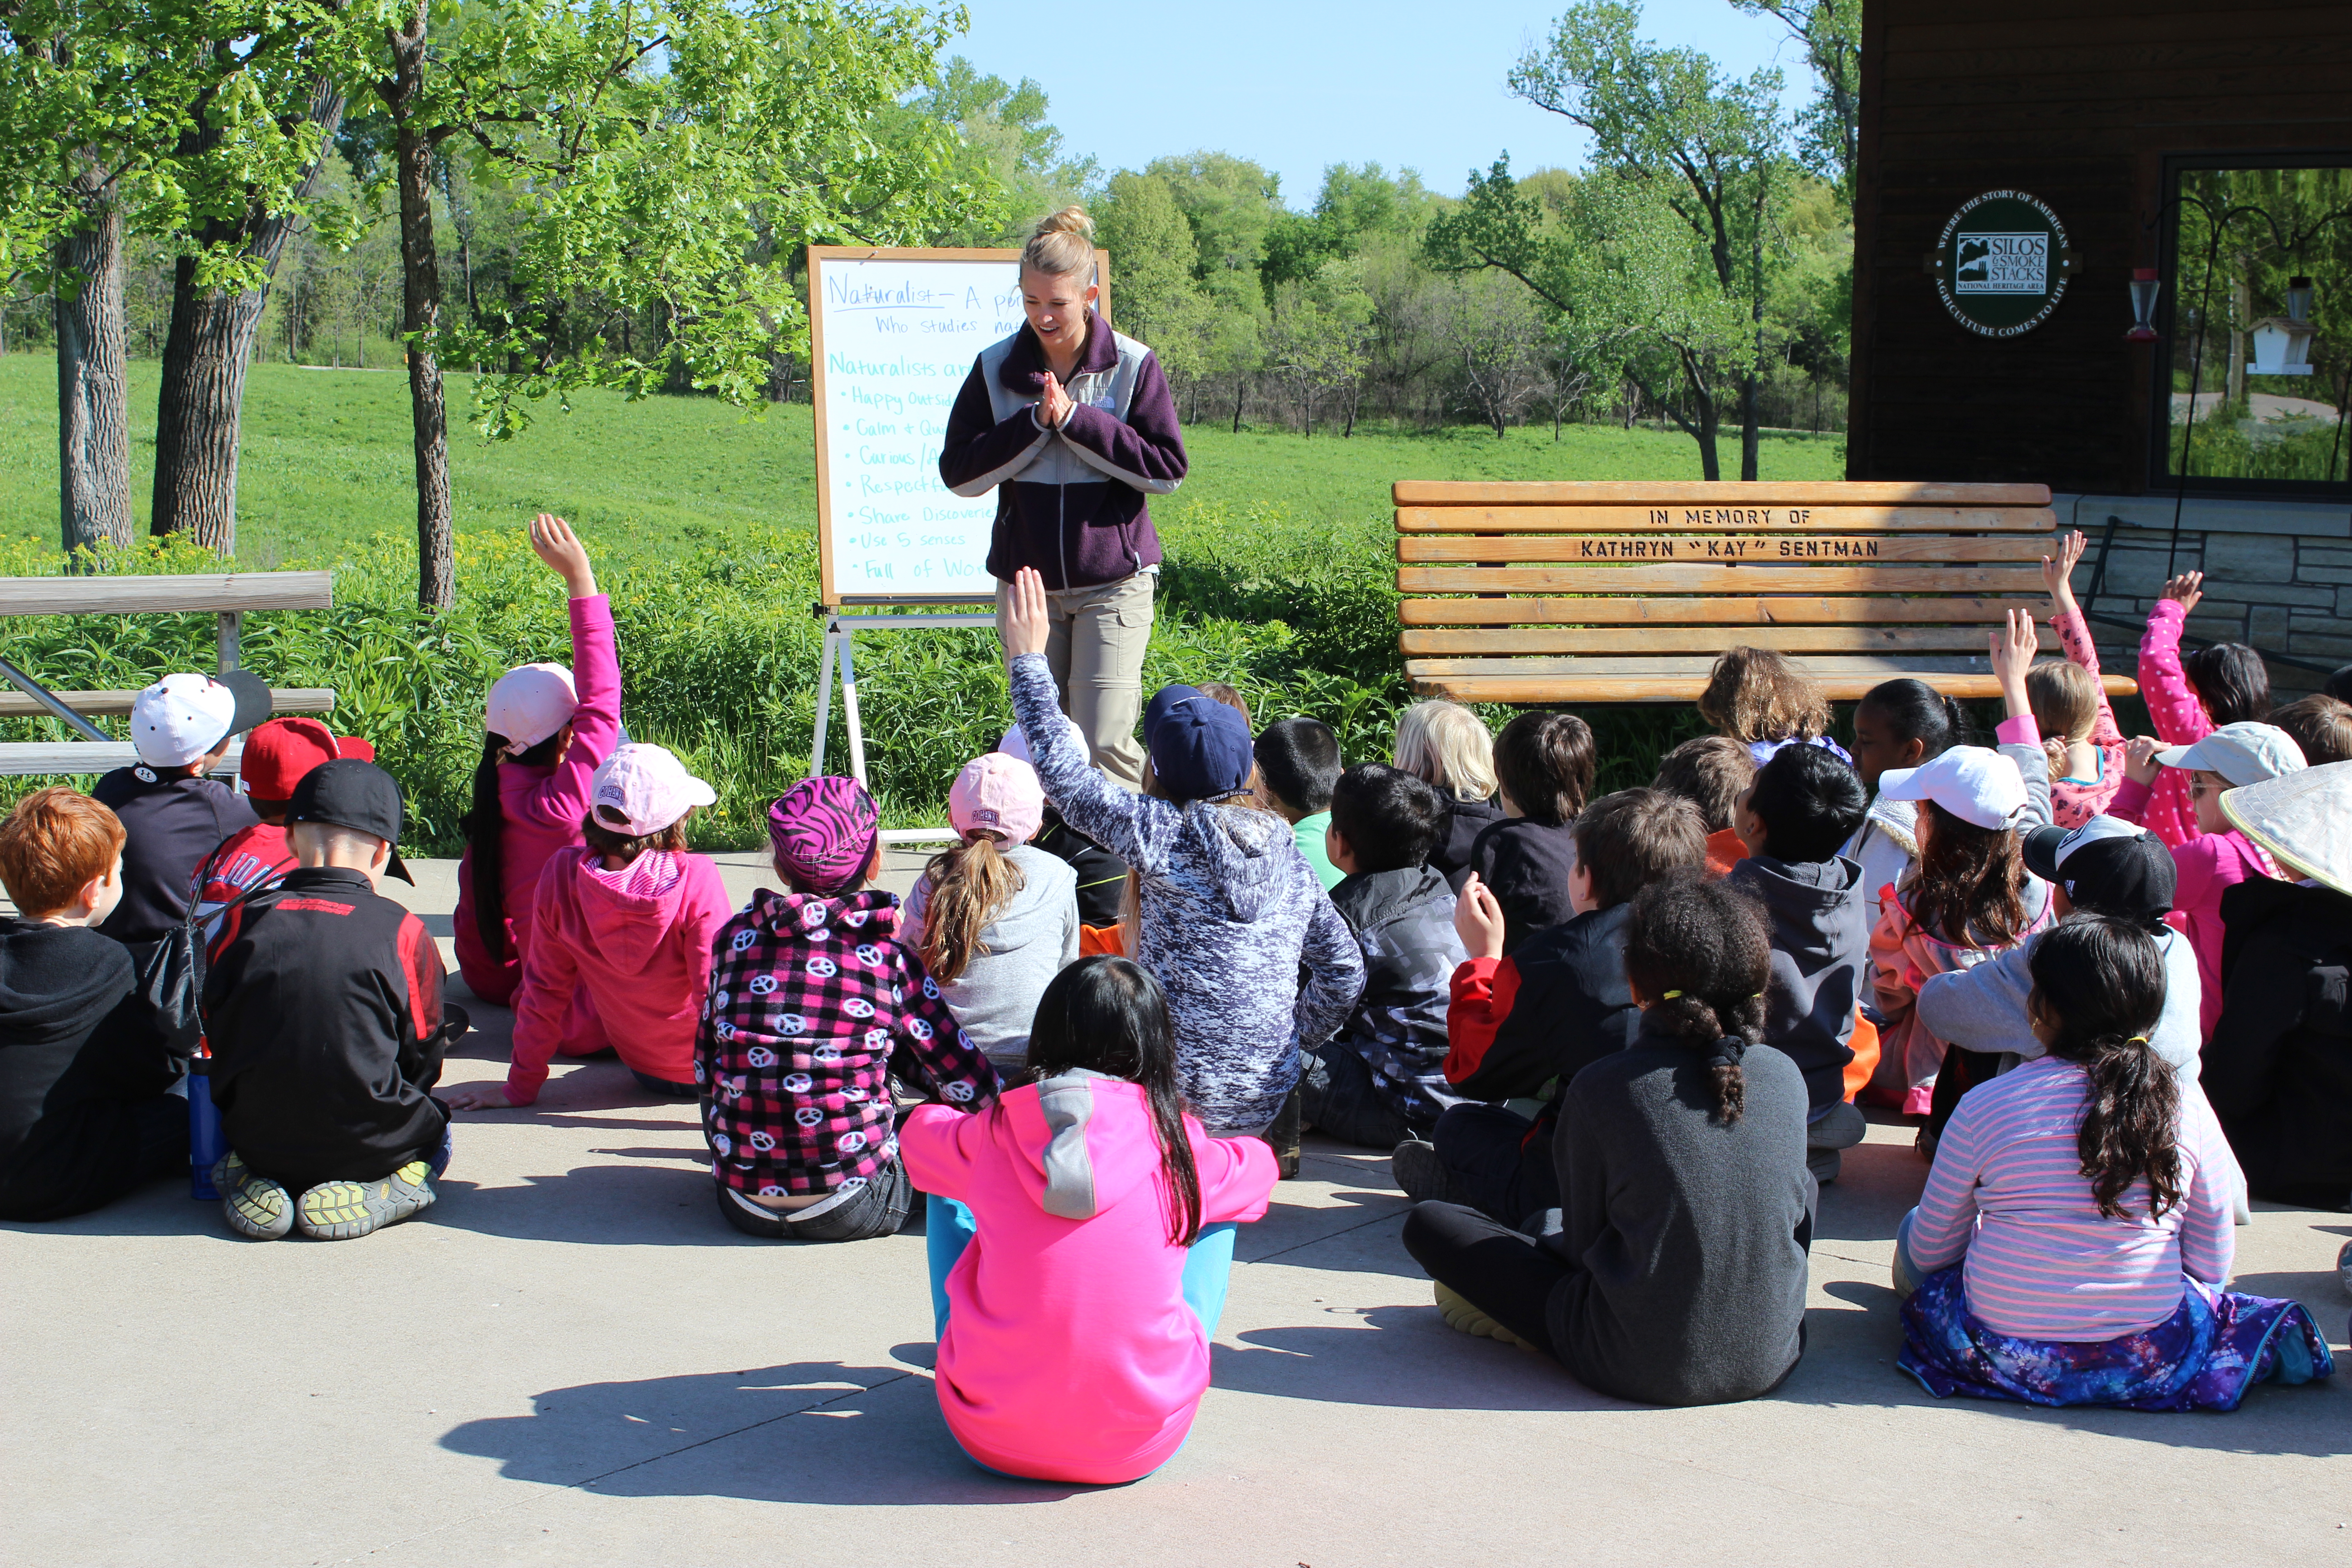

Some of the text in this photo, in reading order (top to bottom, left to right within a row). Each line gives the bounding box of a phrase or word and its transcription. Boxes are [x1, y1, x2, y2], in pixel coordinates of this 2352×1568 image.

[1938, 190, 2069, 249] WHERE THE STORY OF AMERICAN
[1992, 238, 2045, 255] SILOS
[2000, 255, 2044, 267] SMOKE
[1991, 267, 2044, 281] STACKS
[965, 286, 981, 309] A
[1936, 277, 2068, 336] AGRICULTURE COMES TO LIFE
[876, 315, 908, 333] Who
[920, 318, 977, 333] studies
[830, 352, 936, 376] Naturalists
[852, 386, 956, 415] Happy Outsid
[857, 418, 896, 436] Calm
[920, 419, 947, 436] Qui
[860, 445, 915, 465] Curious
[860, 474, 953, 497] Respectfu
[859, 506, 910, 524] Share
[1650, 510, 1810, 524] IN MEMORY OF
[861, 532, 965, 549] Use 5 senses
[1581, 540, 1673, 557] KATHRYN
[1779, 540, 1878, 557] SENTMAN
[865, 559, 894, 580] Full
[914, 559, 932, 578] of
[598, 785, 625, 805] GO HAWKS
[1206, 792, 1229, 803] NOTRE
[972, 809, 1000, 825] GO HAWKS
